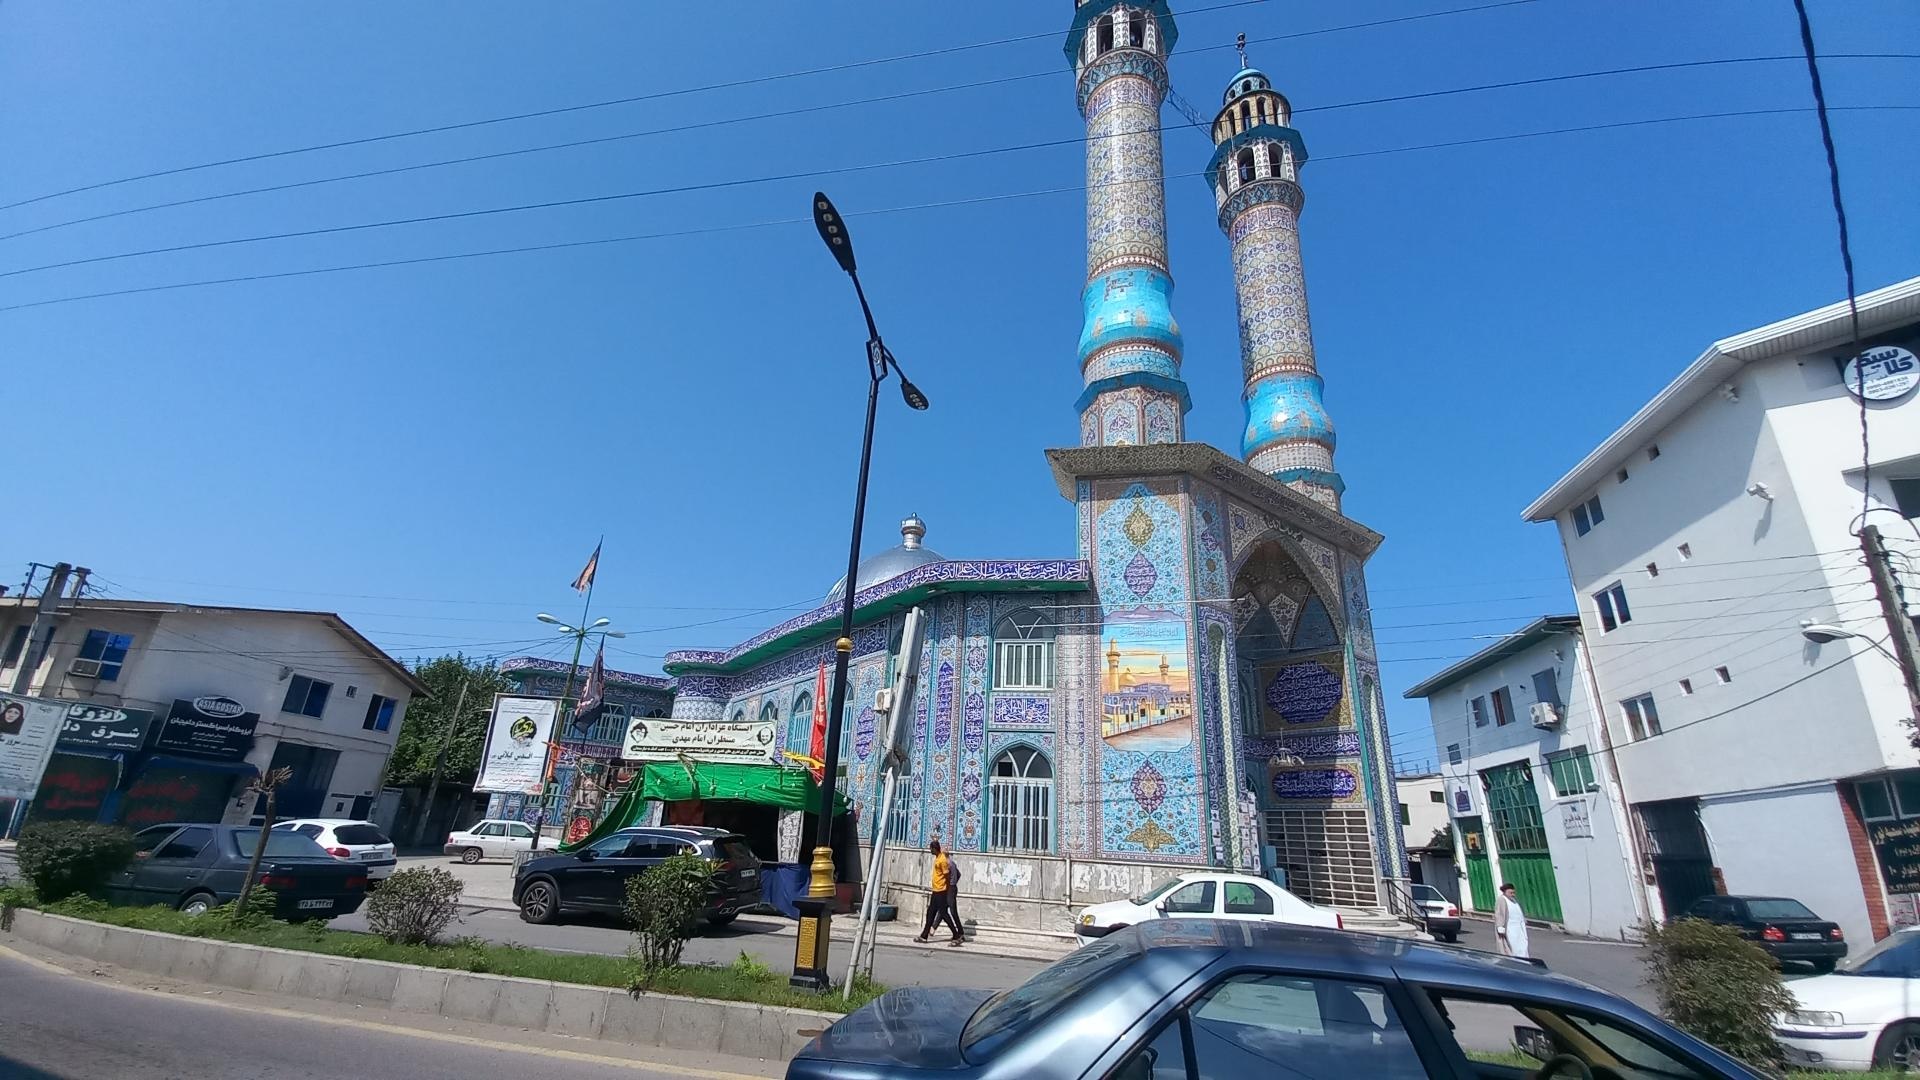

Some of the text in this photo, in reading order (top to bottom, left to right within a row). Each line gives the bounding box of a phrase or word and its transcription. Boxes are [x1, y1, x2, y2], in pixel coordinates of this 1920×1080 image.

[69, 704, 121, 721] ایزوگا
[216, 701, 242, 714] GOSTAR
[660, 723, 680, 732] حسین
[681, 721, 695, 731] امام
[696, 722, 726, 733] عزاداران
[91, 725, 140, 739] شرق
[672, 735, 691, 744] مهدی
[691, 734, 707, 744] امام
